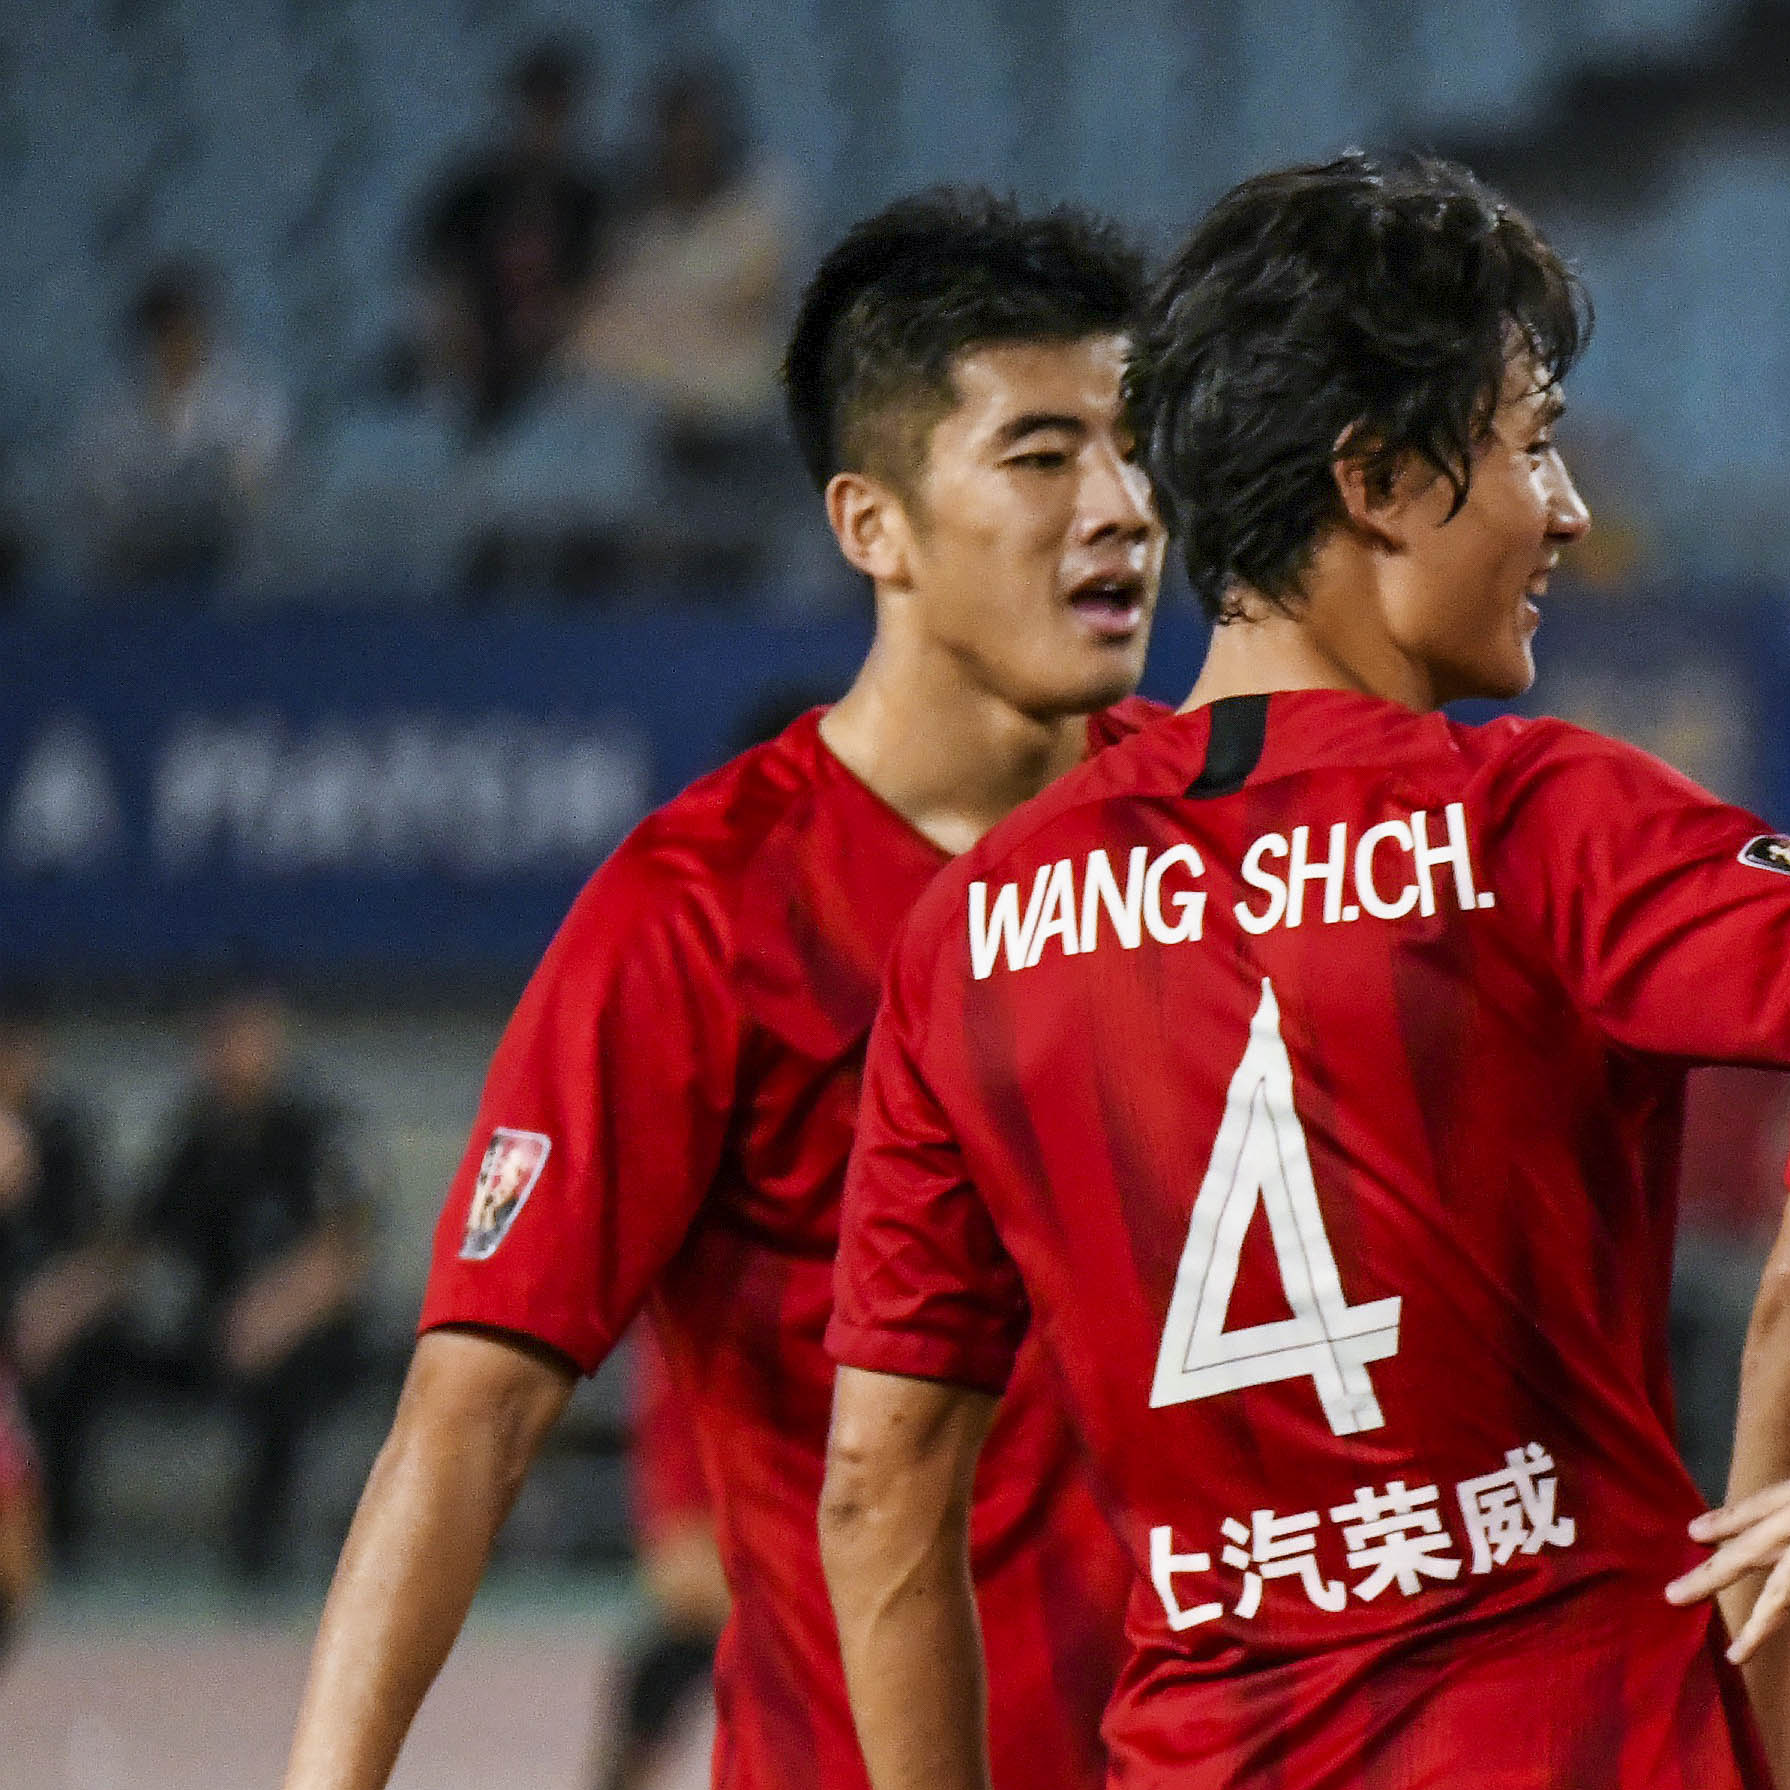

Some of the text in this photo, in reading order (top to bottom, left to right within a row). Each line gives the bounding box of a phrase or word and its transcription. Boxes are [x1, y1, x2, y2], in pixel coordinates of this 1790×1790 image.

[968, 802, 1495, 980] WANG SH.CH.
[1149, 976, 1401, 1437] 4
[1150, 1441, 1575, 1632] 上汽荣威
